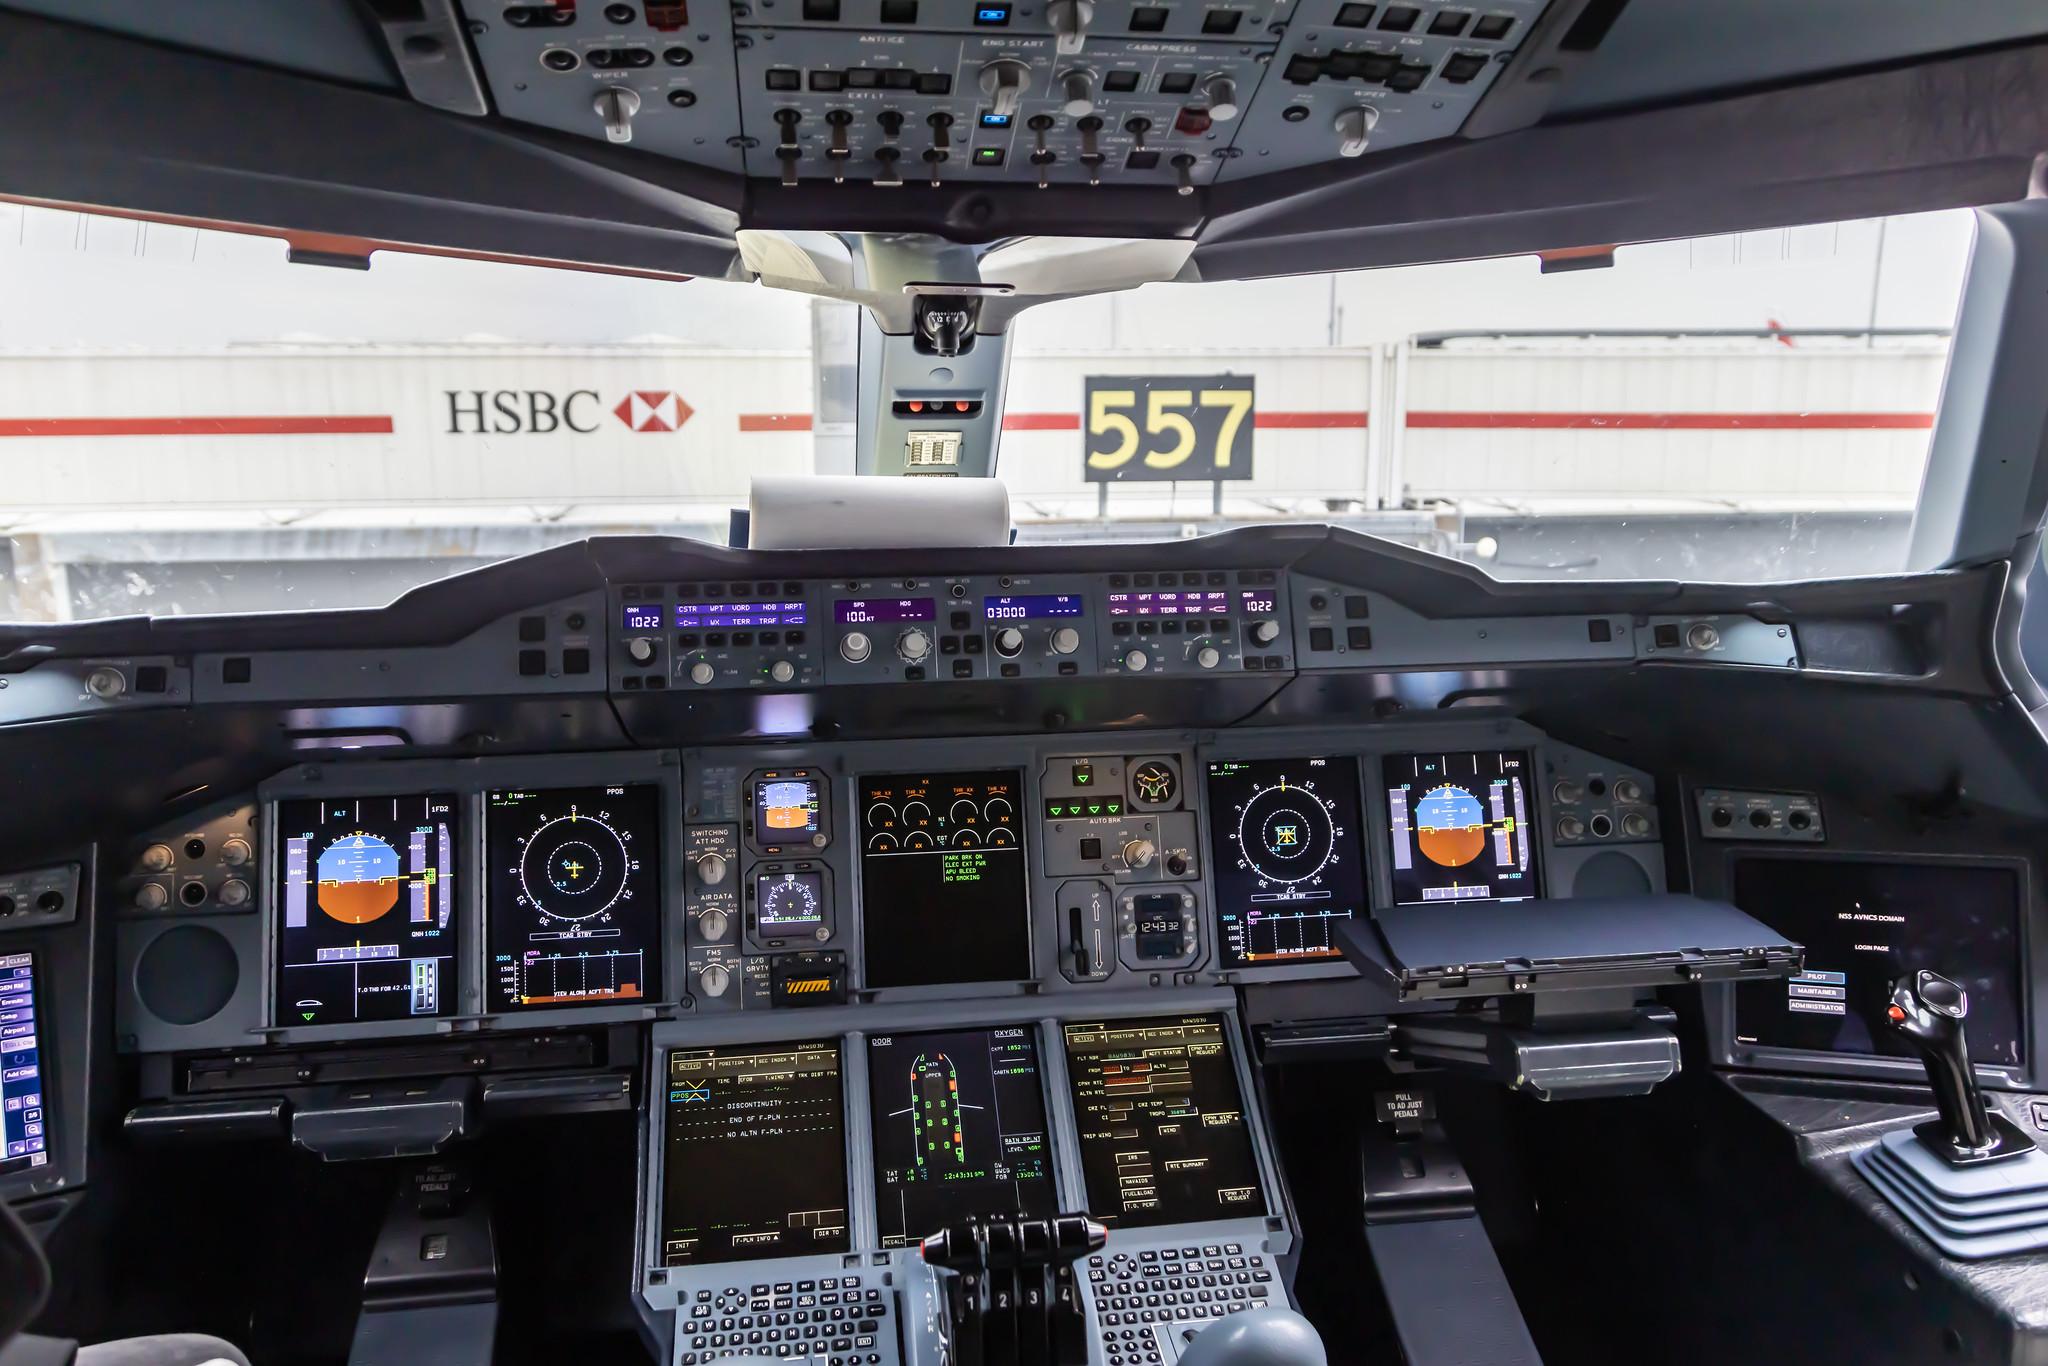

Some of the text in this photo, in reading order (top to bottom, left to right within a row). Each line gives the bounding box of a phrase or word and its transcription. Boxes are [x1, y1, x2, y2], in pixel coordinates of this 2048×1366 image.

[1008, 40, 1045, 48] START
[1401, 37, 1424, 46] ENG
[1126, 44, 1198, 52] CABIN PRESS
[1353, 90, 1386, 98] WIPER
[444, 390, 600, 434] HSBC
[1087, 390, 1252, 470] 557
[1246, 600, 1272, 612] 1022
[846, 612, 866, 622] 100
[987, 607, 1026, 618] 03000
[631, 616, 660, 628] 1022
[1305, 780, 1314, 790] 12
[1326, 800, 1336, 809] 15
[600, 810, 610, 820] 12
[622, 831, 632, 841] 15
[691, 829, 728, 837] SWITCHING
[632, 860, 639, 870] 18
[517, 895, 527, 906] 33
[540, 916, 550, 926] 30
[1168, 922, 1178, 930] 32
[1791, 1003, 1844, 1011] ADMINISTRATOR
[3, 1026, 26, 1035] Airport
[727, 1100, 782, 1110] DISCONTINUITY
[421, 1184, 448, 1192] PEDALS
[1030, 1291, 1038, 1304] 3
[1062, 1288, 1069, 1301] 4
[967, 1297, 974, 1310] 1
[1000, 1295, 1007, 1308] 2
